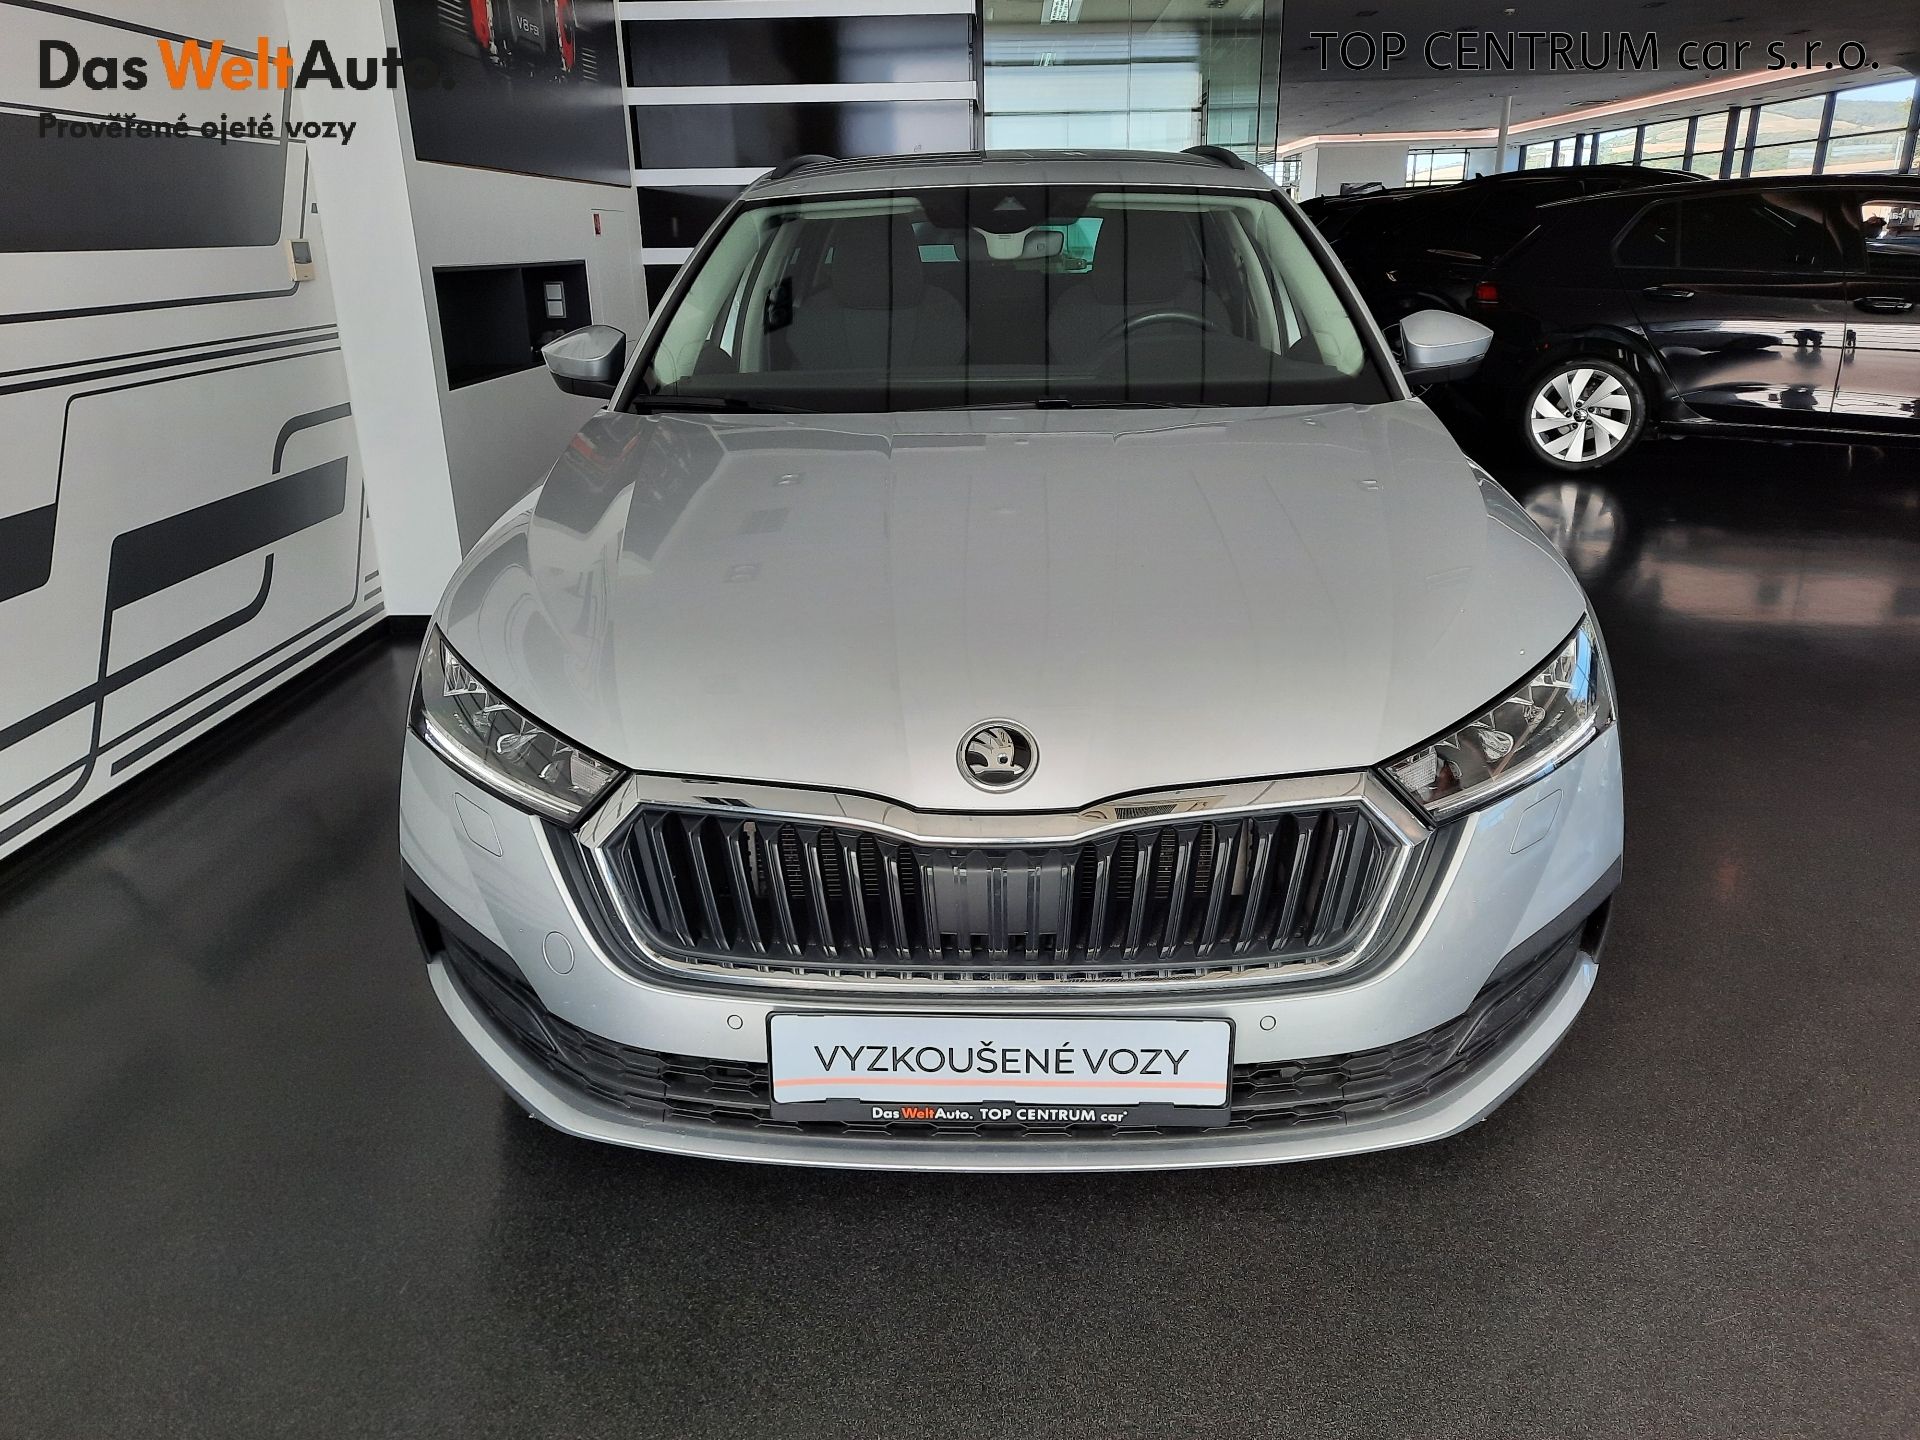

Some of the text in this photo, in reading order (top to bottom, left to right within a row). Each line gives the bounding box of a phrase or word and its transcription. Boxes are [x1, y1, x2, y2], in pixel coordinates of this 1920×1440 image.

[814, 1040, 1190, 1075] VYZKOUŠENÉ VOZY
[872, 1107, 900, 1119] Das
[980, 1108, 1012, 1121] TOP
[1016, 1108, 1096, 1122] CENTRUM
